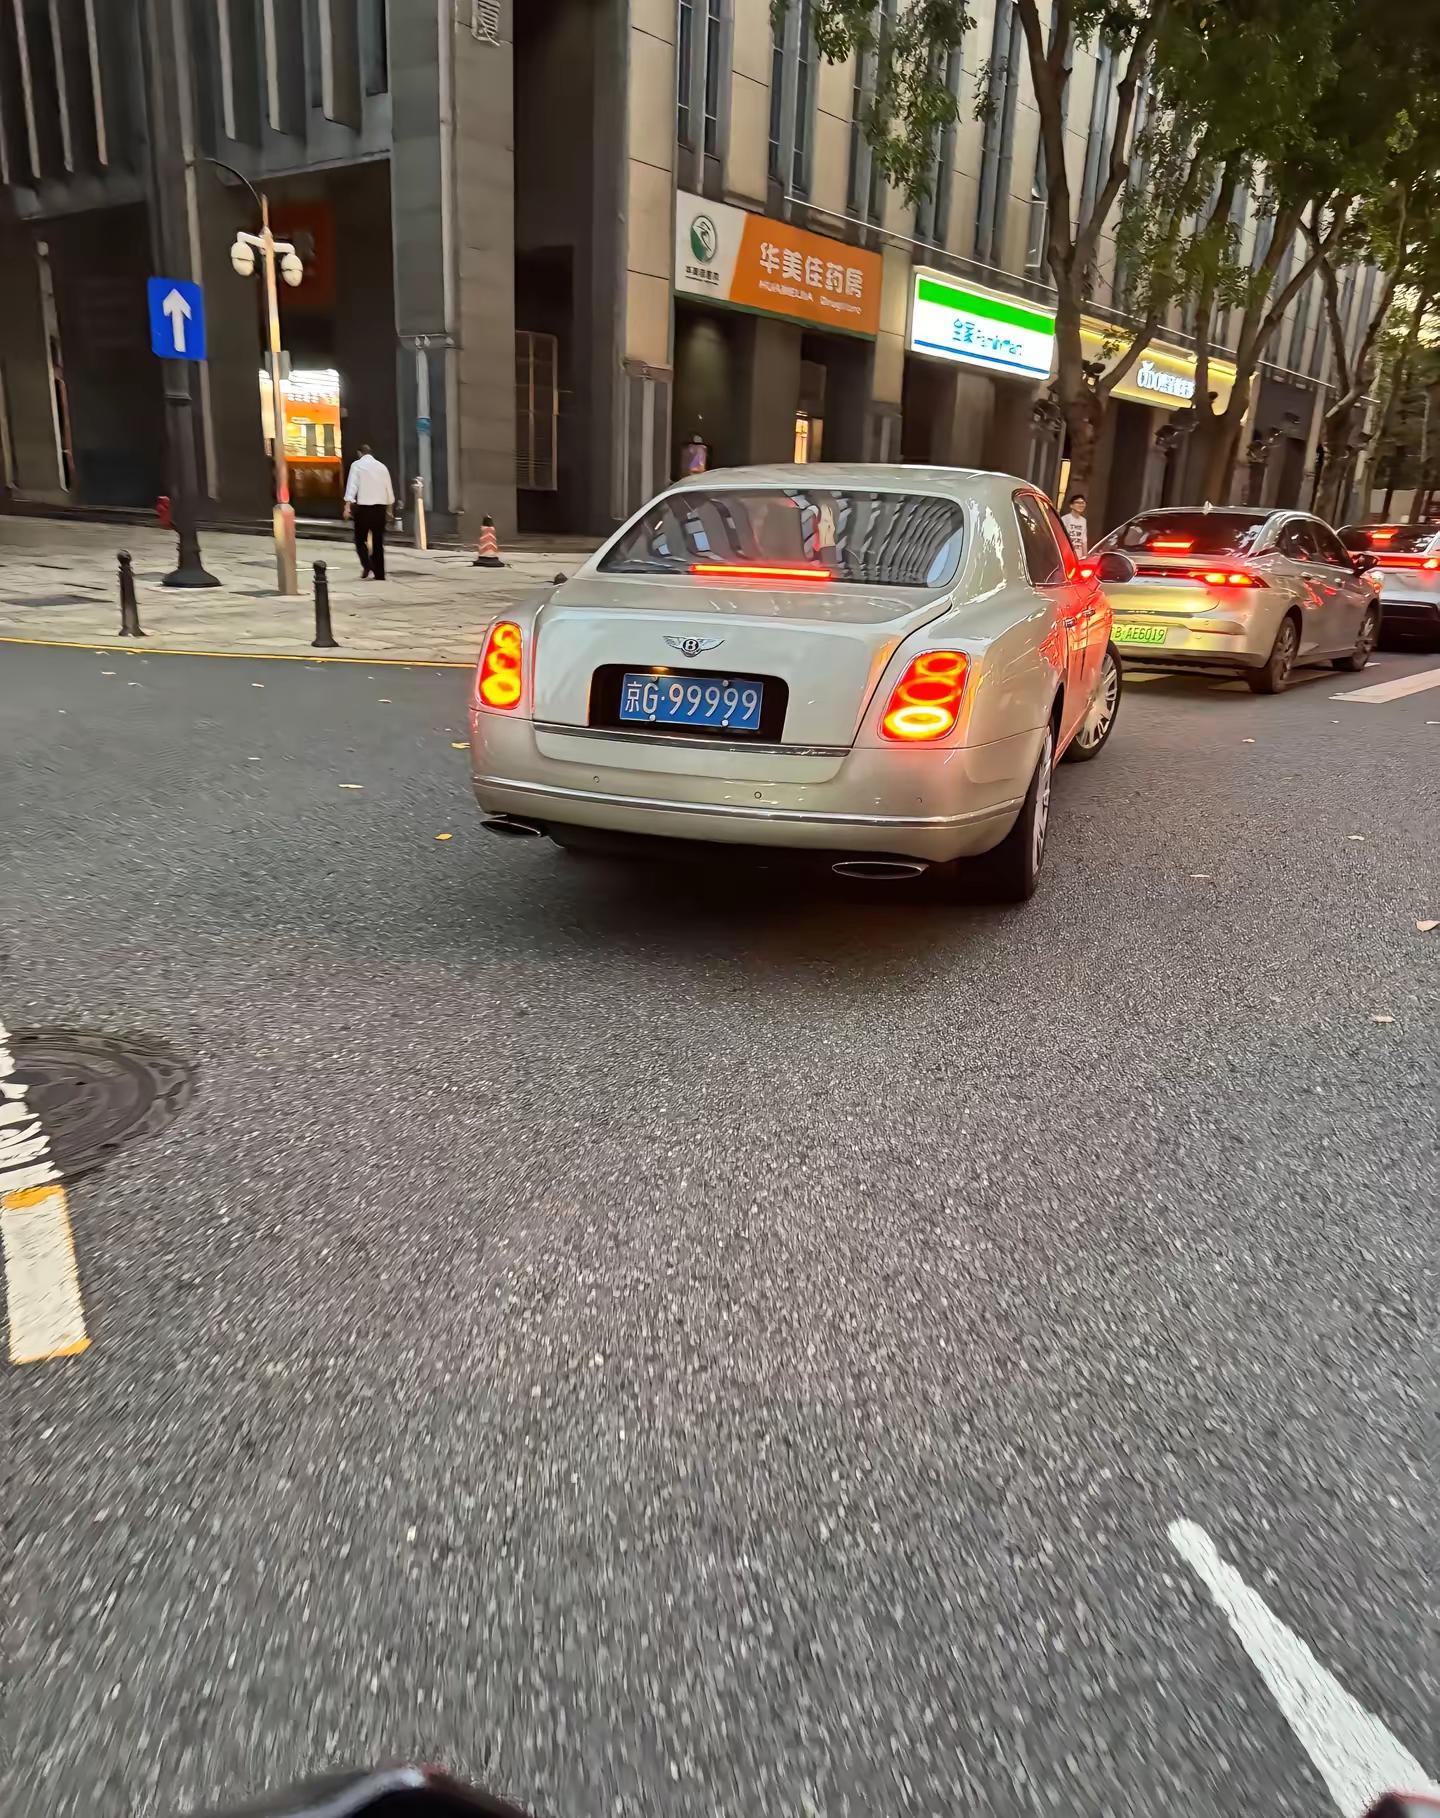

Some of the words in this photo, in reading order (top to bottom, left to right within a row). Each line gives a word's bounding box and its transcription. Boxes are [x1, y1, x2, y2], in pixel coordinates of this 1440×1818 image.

[759, 242, 864, 298] 华美佳药房
